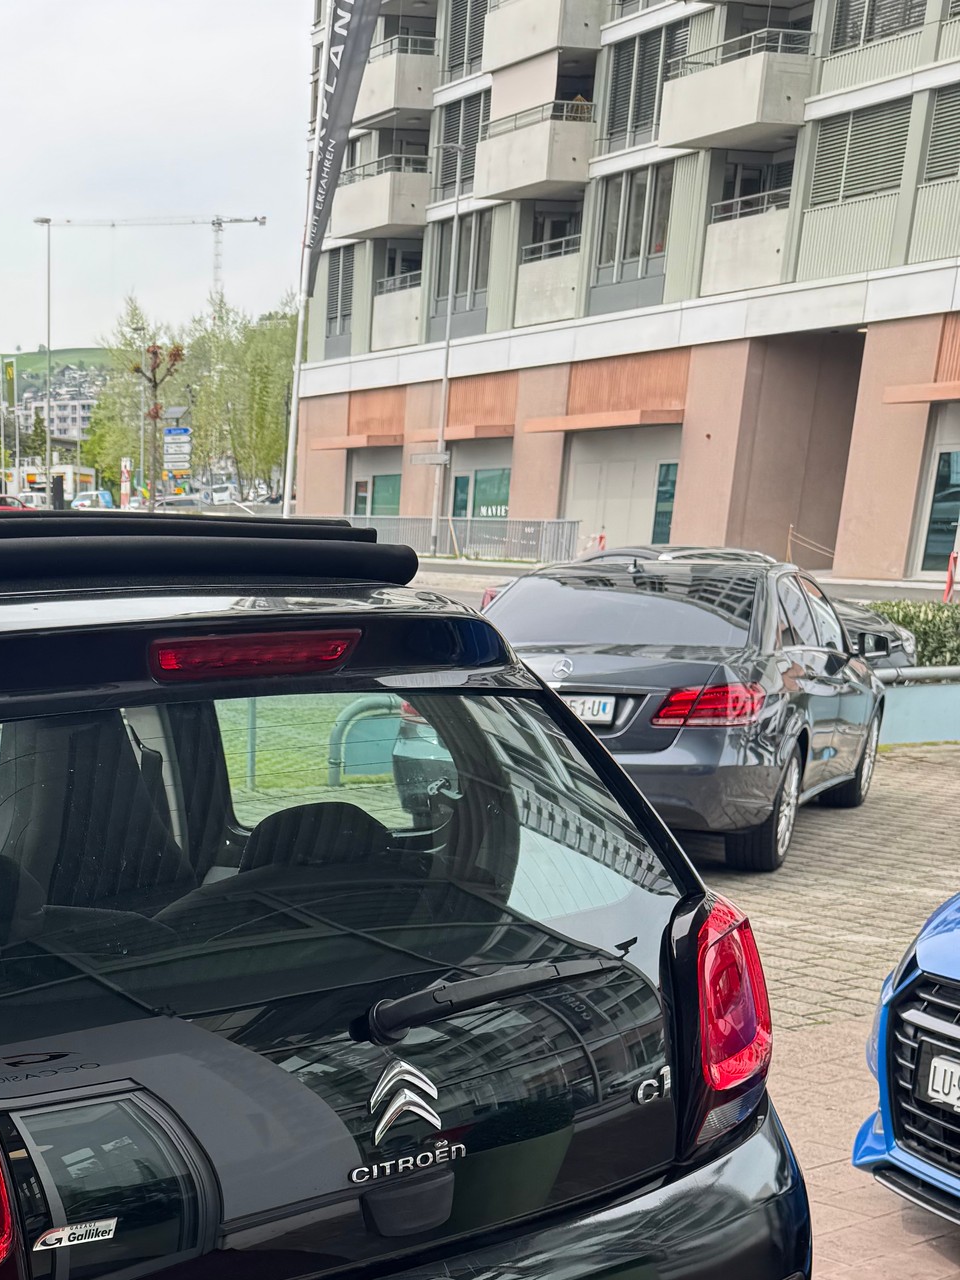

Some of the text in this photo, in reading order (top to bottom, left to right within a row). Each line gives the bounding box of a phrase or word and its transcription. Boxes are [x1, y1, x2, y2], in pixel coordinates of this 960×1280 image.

[315, 139, 337, 210] ERFAHREN
[637, 1065, 671, 1105] C1
[67, 1228, 113, 1243] Galliker
